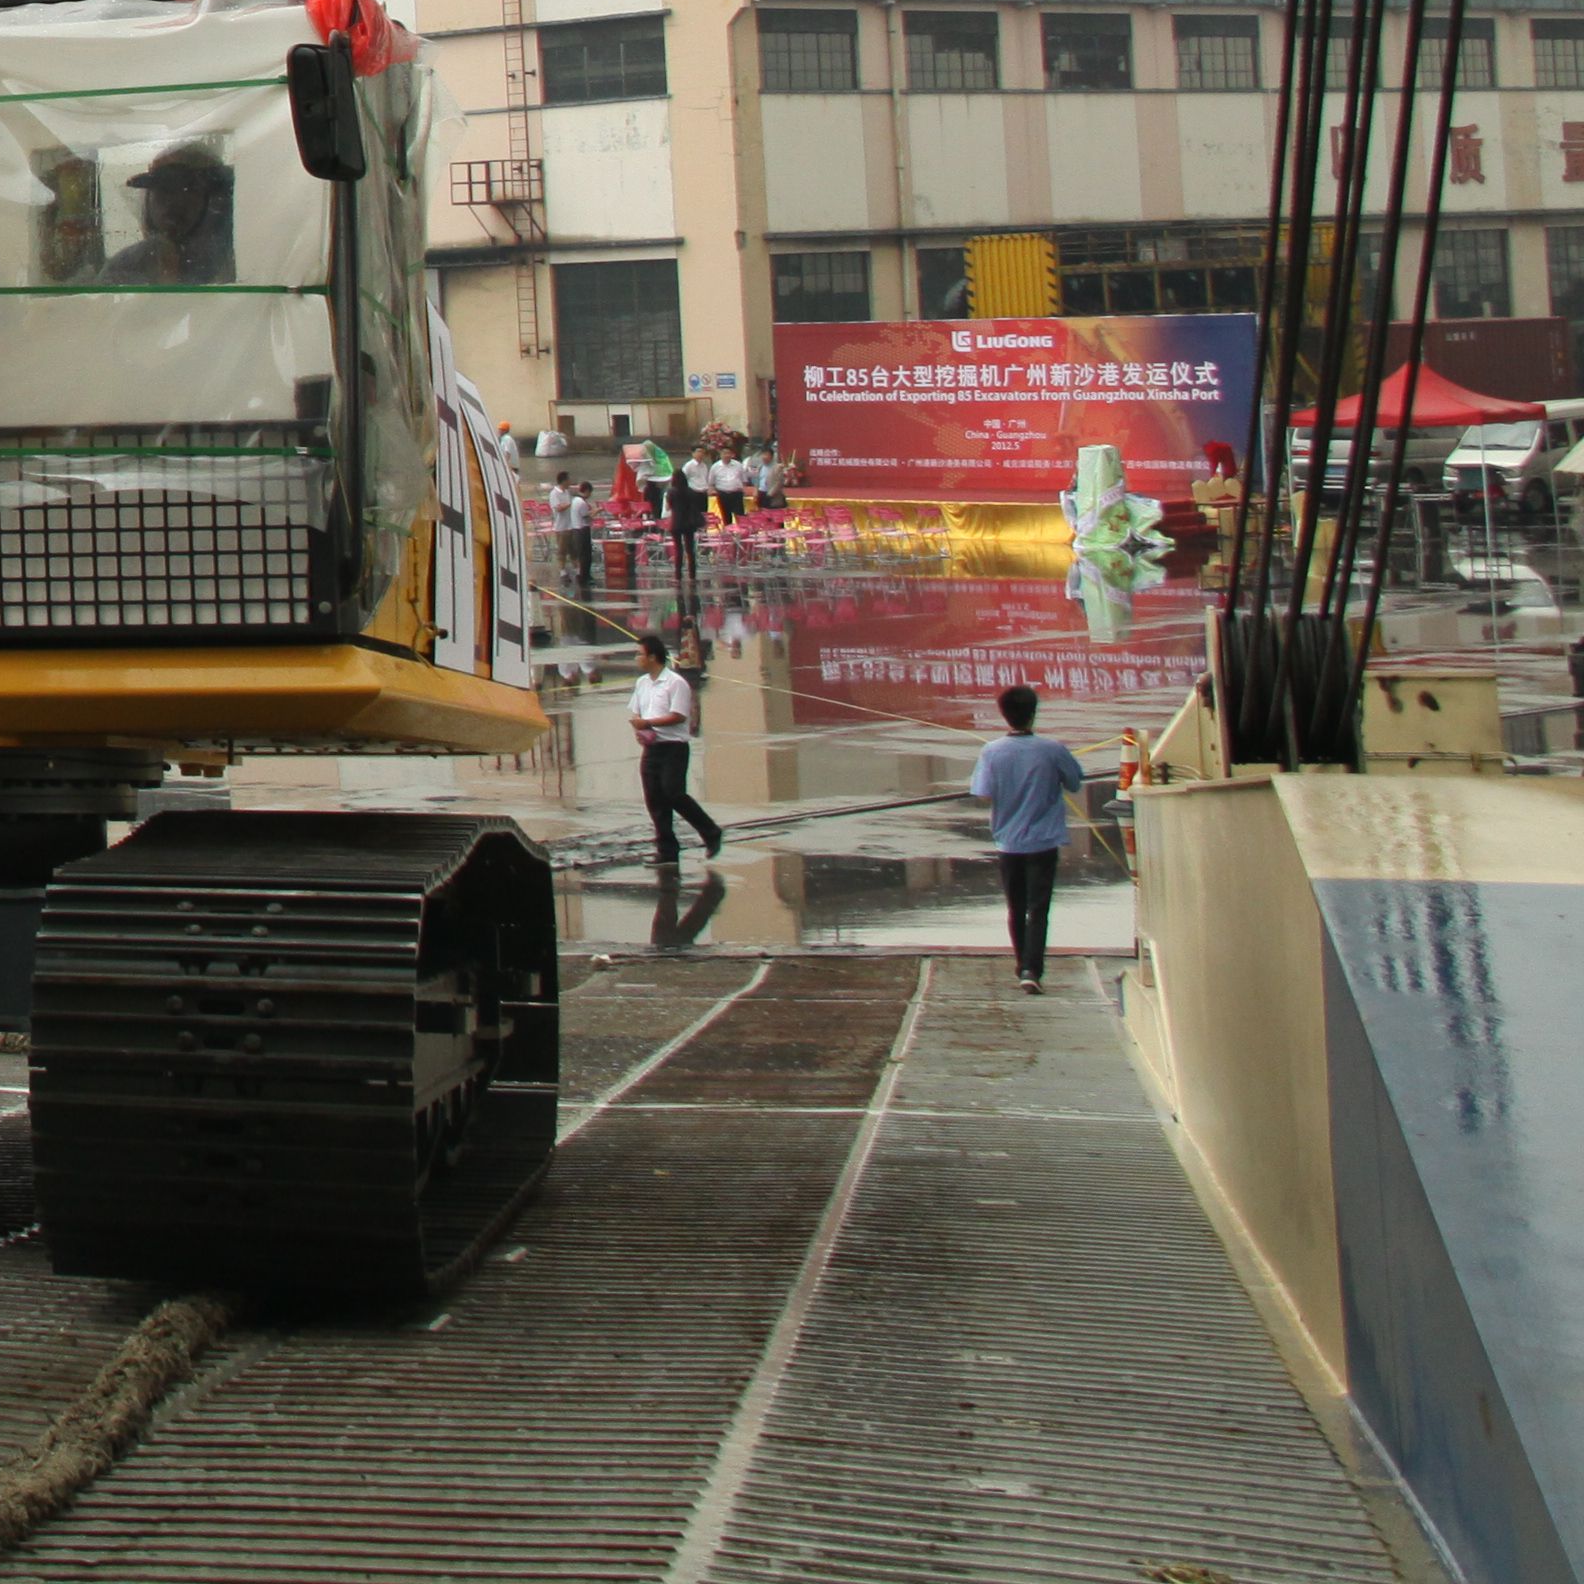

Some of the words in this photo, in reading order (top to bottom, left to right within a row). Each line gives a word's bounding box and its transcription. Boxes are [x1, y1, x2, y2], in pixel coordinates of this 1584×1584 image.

[804, 361, 1219, 388] 柳工85台大型挖掘机广州新沙港发运仪式
[806, 390, 817, 402] In
[819, 390, 883, 402] Celebration
[885, 390, 898, 402] of
[900, 390, 955, 404] Exporting
[957, 390, 972, 401] 85
[974, 390, 1039, 401] Excavators
[1041, 389, 1070, 401] from
[1073, 389, 1144, 403] Guangzhou
[1147, 389, 1189, 400] Xinsha
[1192, 389, 1220, 400] Port
[992, 441, 1020, 450] 2012.5
